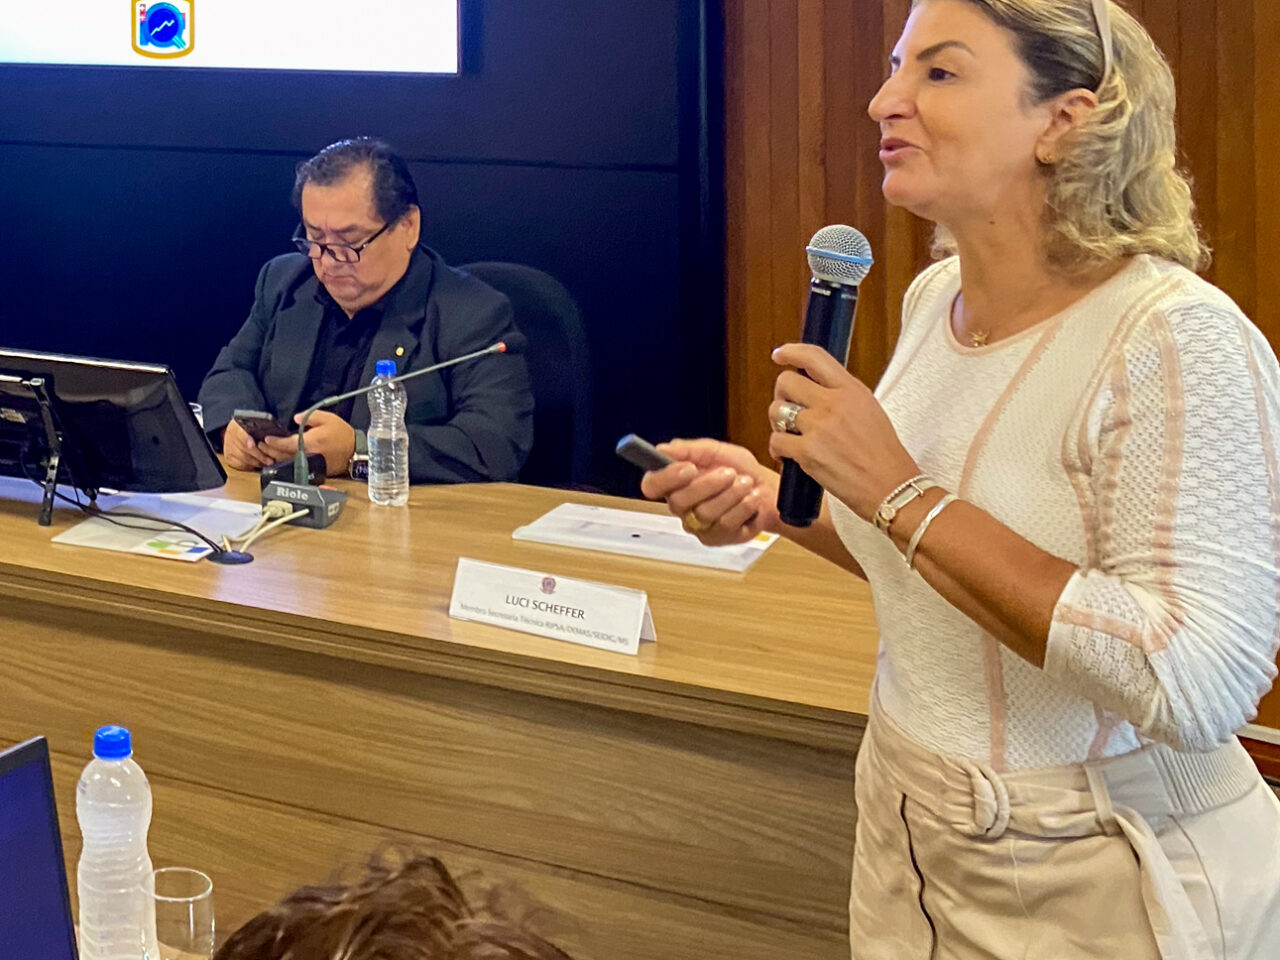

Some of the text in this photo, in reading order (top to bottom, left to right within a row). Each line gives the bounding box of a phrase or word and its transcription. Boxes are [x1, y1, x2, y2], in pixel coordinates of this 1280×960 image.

[276, 486, 309, 500] Riole
[506, 594, 586, 620] LUCI SCHEFFER
